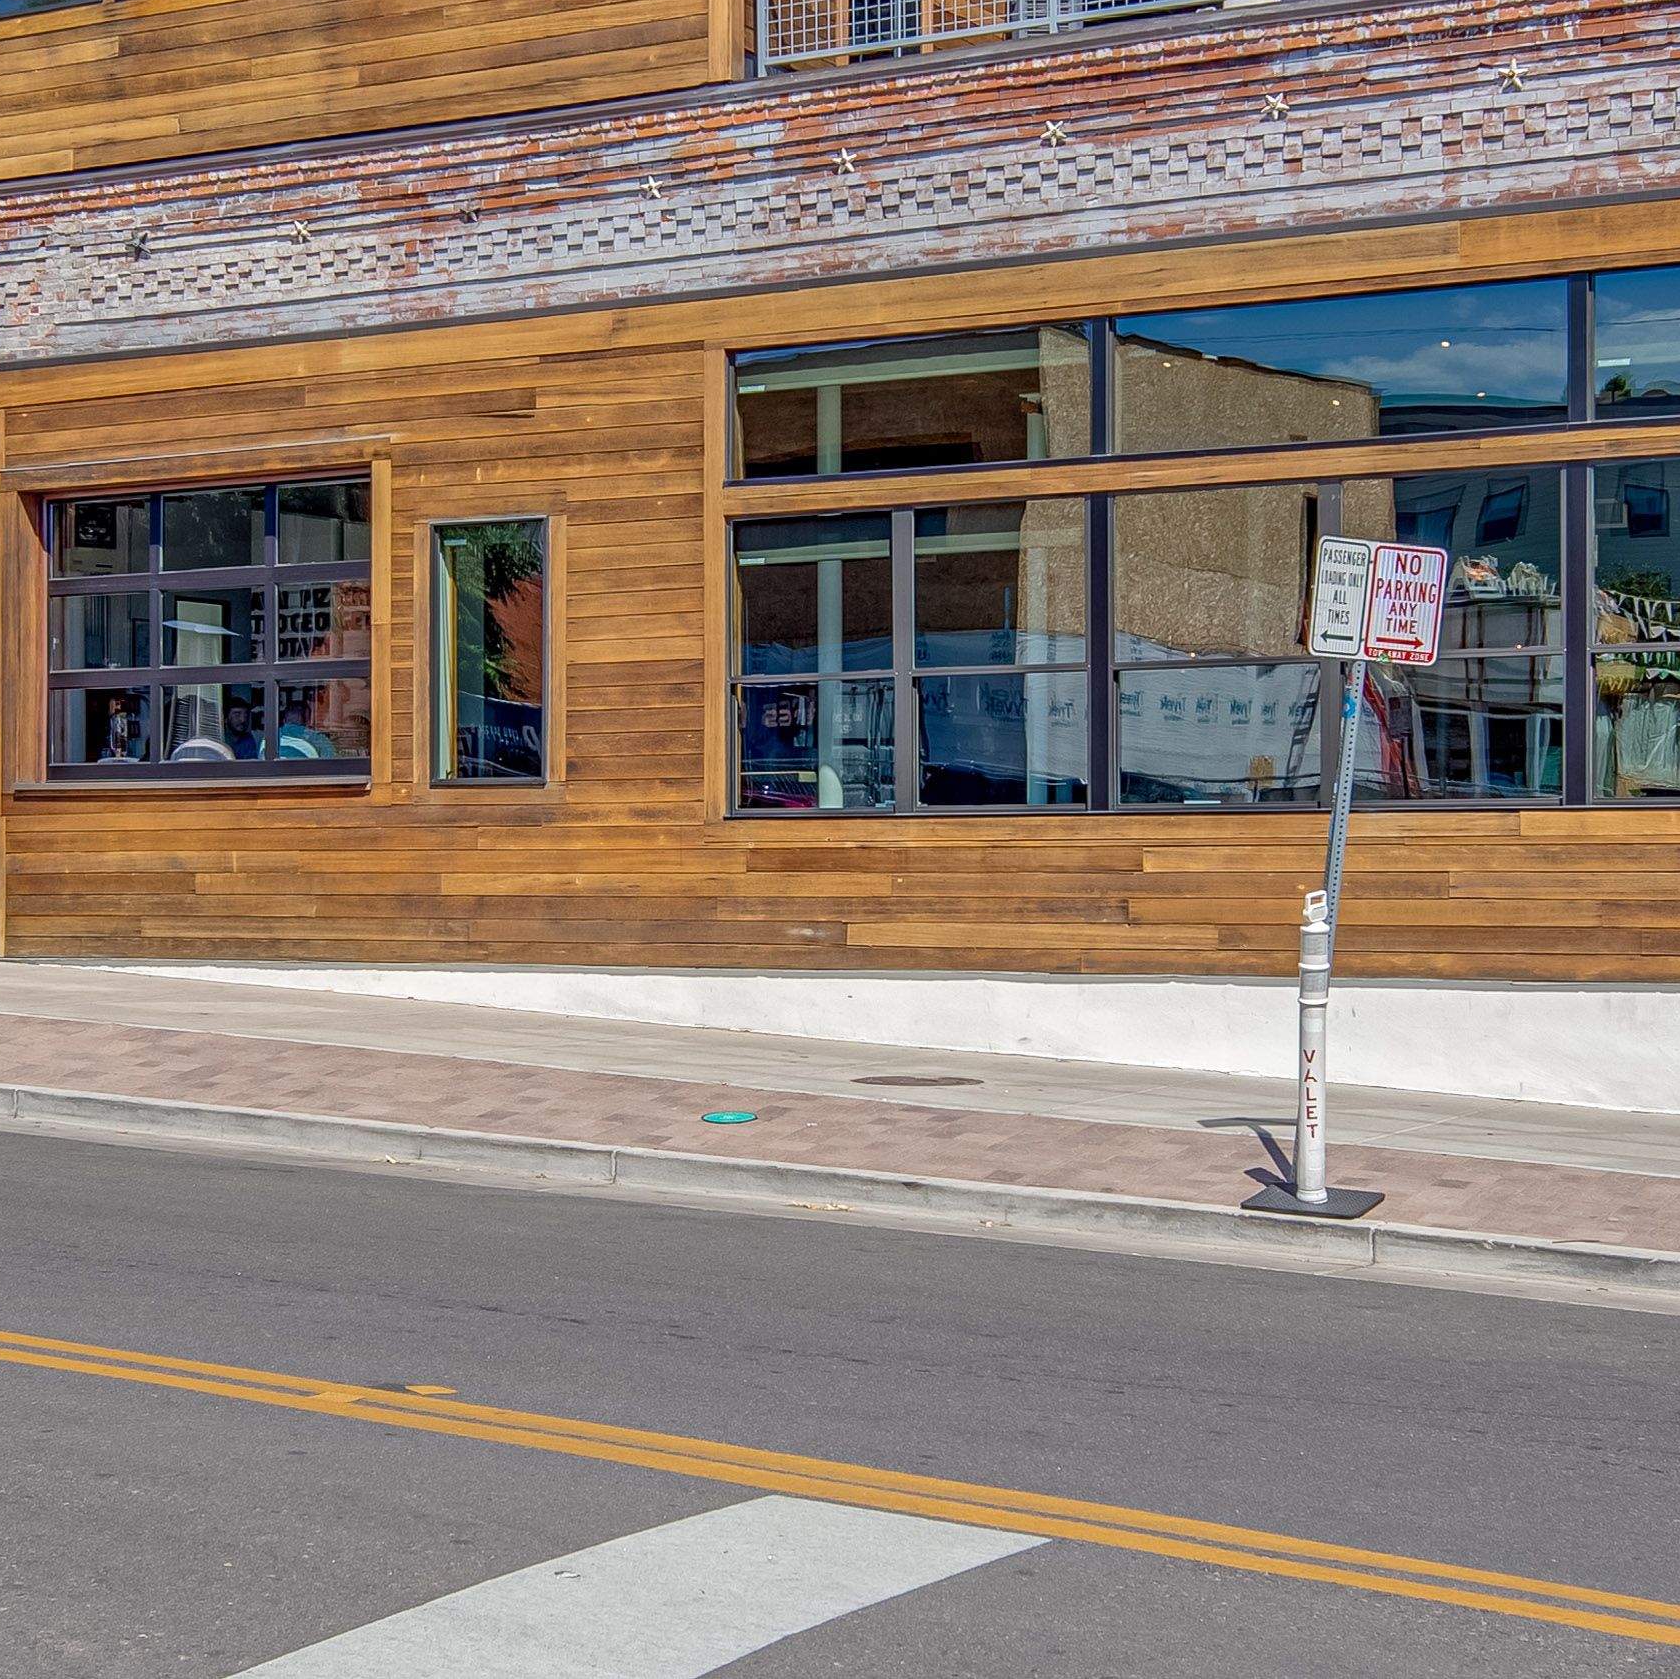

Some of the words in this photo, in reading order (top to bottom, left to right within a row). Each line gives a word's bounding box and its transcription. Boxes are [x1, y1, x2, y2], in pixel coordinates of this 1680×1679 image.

[1323, 548, 1366, 567] PASSENGER
[1395, 553, 1422, 576] NO
[1321, 569, 1348, 587] LOADING
[1348, 572, 1364, 588] ONLY
[1332, 590, 1348, 605] ALL
[1375, 578, 1437, 604] PARKING
[1328, 609, 1350, 625] TIMES
[1388, 601, 1418, 617] ANY
[1386, 618, 1418, 634] TIME
[1303, 1049, 1318, 1139] VALET
